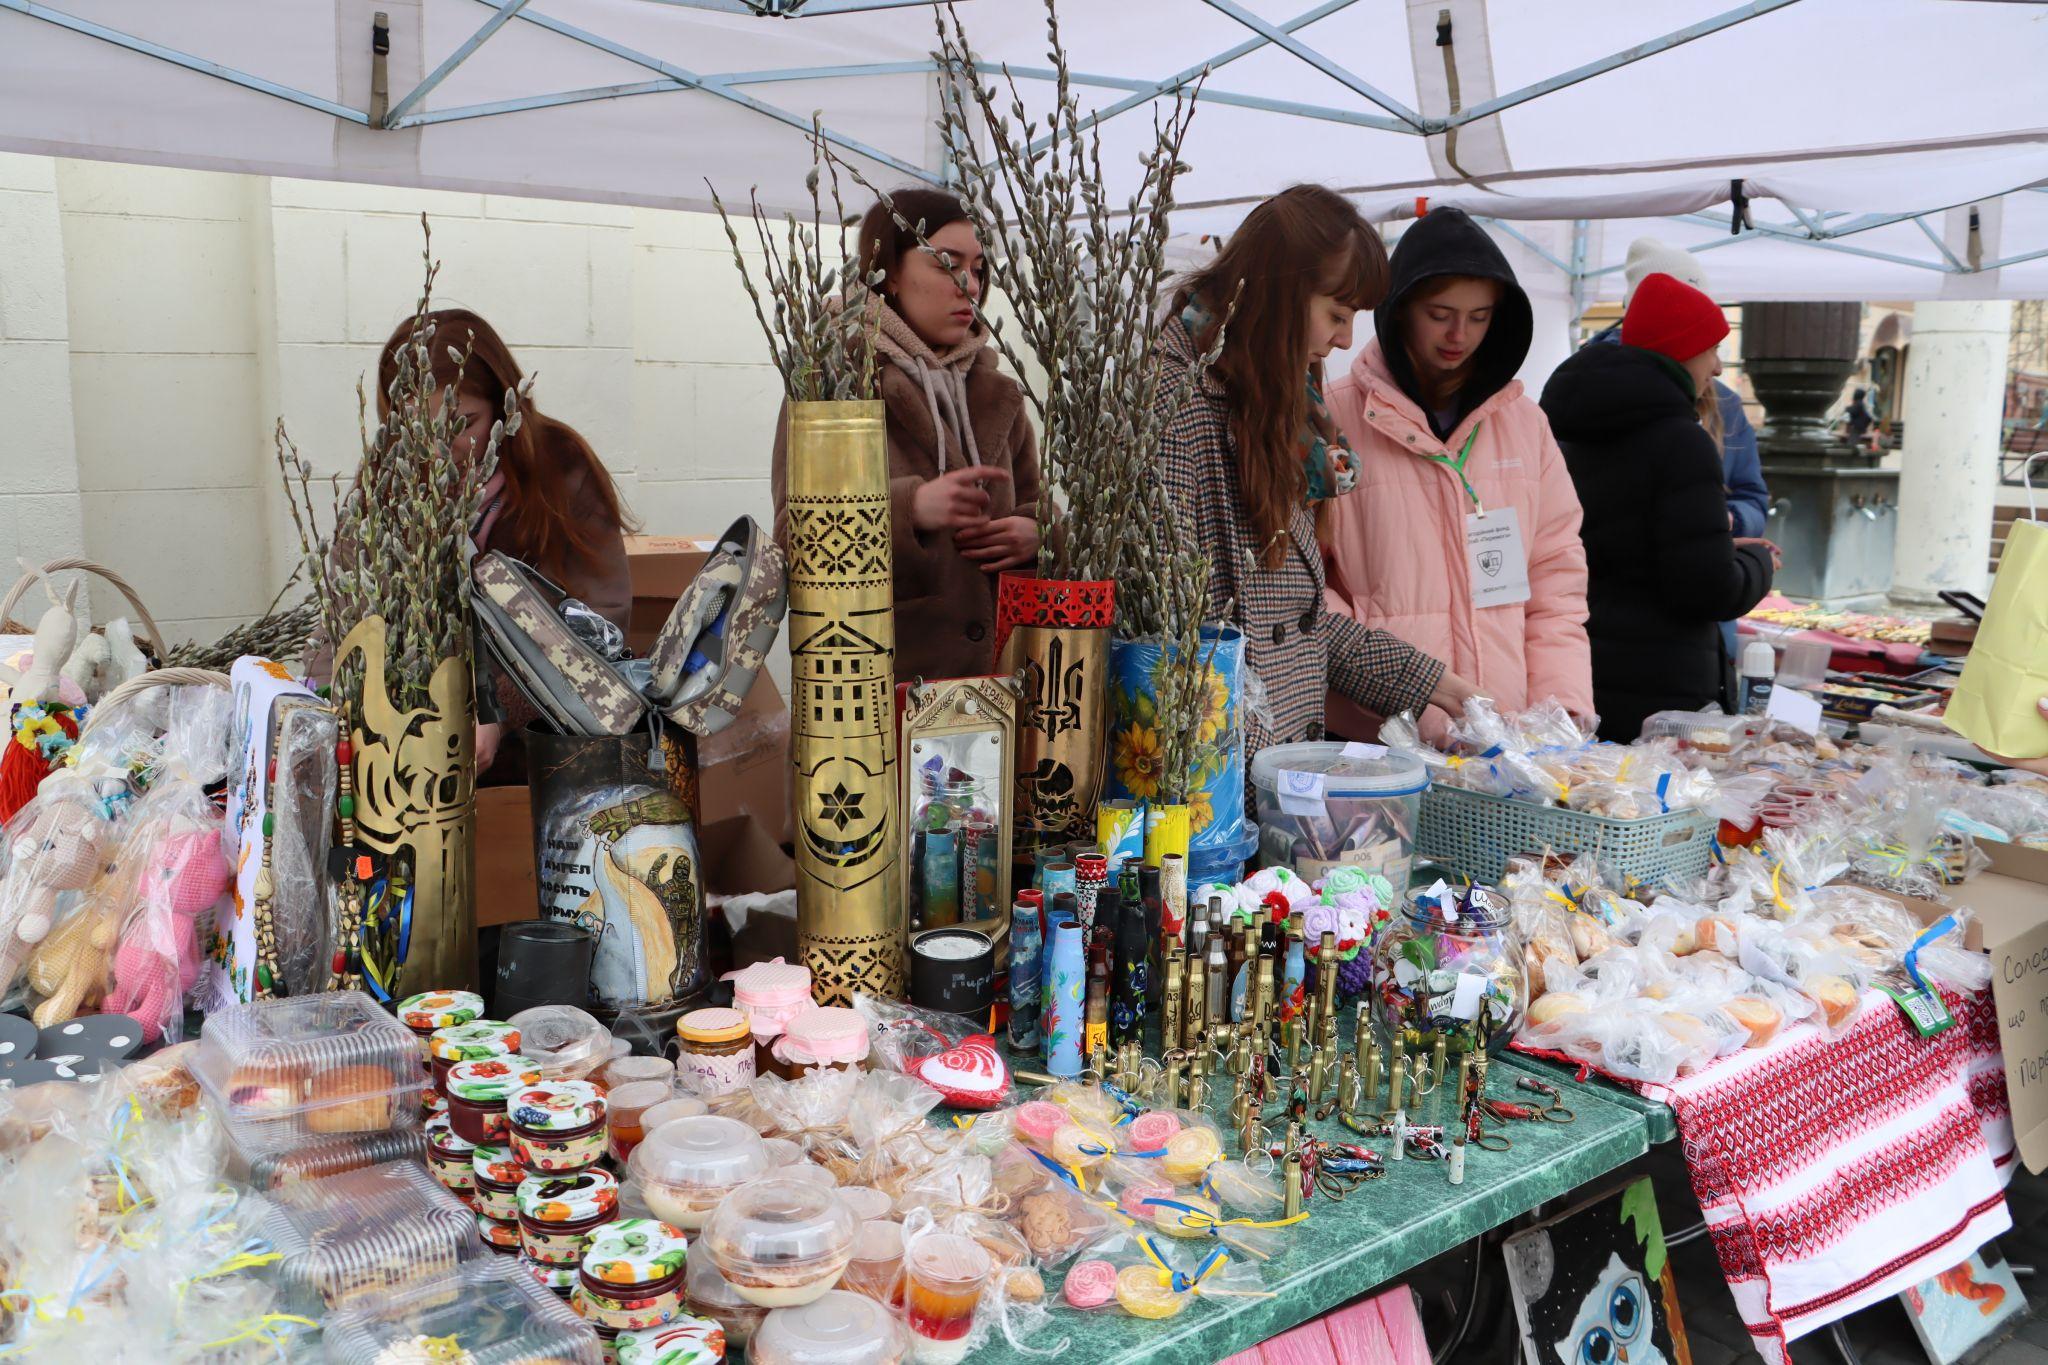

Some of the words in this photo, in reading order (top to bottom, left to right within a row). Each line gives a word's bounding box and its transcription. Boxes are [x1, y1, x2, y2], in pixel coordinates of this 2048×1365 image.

[547, 838, 580, 851] НАШ
[544, 859, 592, 875] АНГЕЛ
[541, 881, 591, 898] НОСИТЬ
